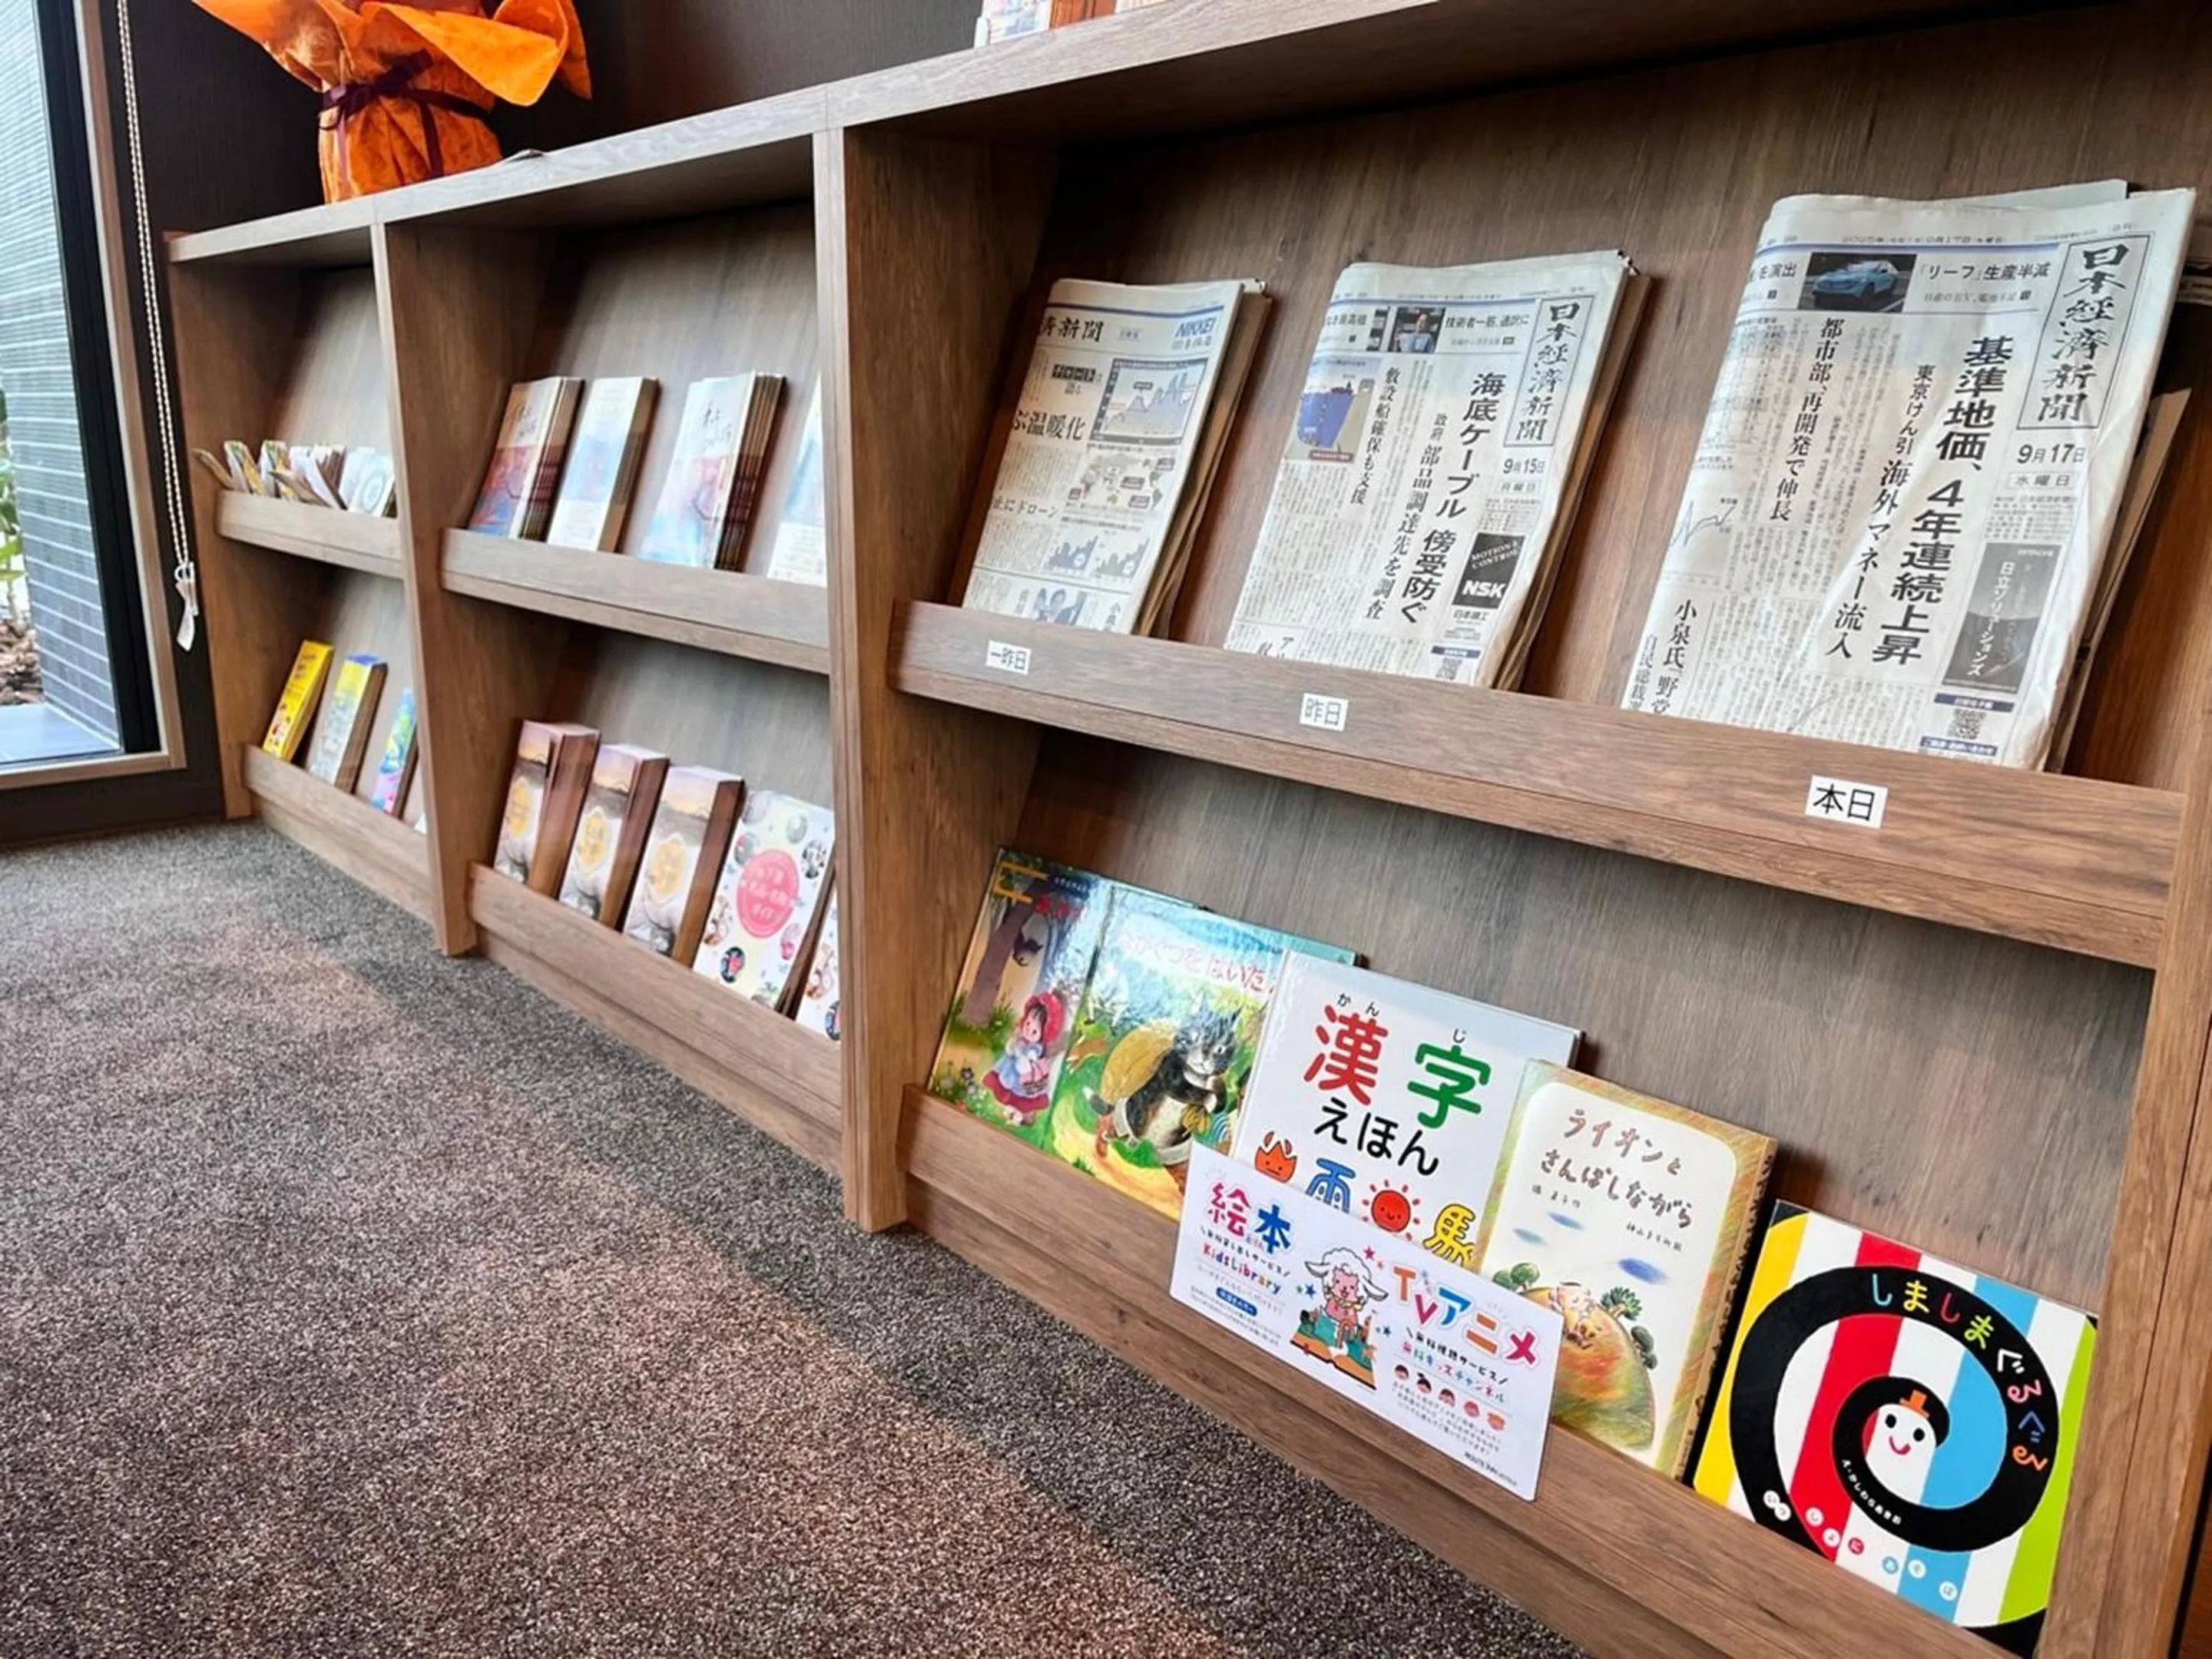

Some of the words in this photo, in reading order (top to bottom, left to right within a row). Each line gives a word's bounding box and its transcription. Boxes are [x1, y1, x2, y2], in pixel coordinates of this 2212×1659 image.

[1435, 372, 1507, 519] 海底ケーブル
[1770, 317, 1845, 522] 都市部、再開発で伸長
[2017, 443, 2086, 464] 9月17日
[1503, 458, 1545, 475] 9月15日
[2015, 473, 2071, 486] 水曜日
[1402, 528, 1457, 624] 傍受防ぐ
[1462, 580, 1505, 598] NSK
[1826, 459, 1911, 659] 海外マネー流入
[991, 647, 1027, 671] 一昨日
[1304, 697, 1343, 727] 昨日
[1813, 783, 1875, 822] 本日
[1336, 992, 1380, 1018] かん
[1452, 1027, 1469, 1044] じ
[1303, 1004, 1492, 1129] 漢字
[1313, 1096, 1439, 1177] えほん
[1564, 1108, 1681, 1176] ライオンと
[1208, 1183, 1291, 1254] 絵本
[1393, 1266, 1536, 1365] TVアニメ
[1872, 1273, 2048, 1472] しましまぐるぐる
